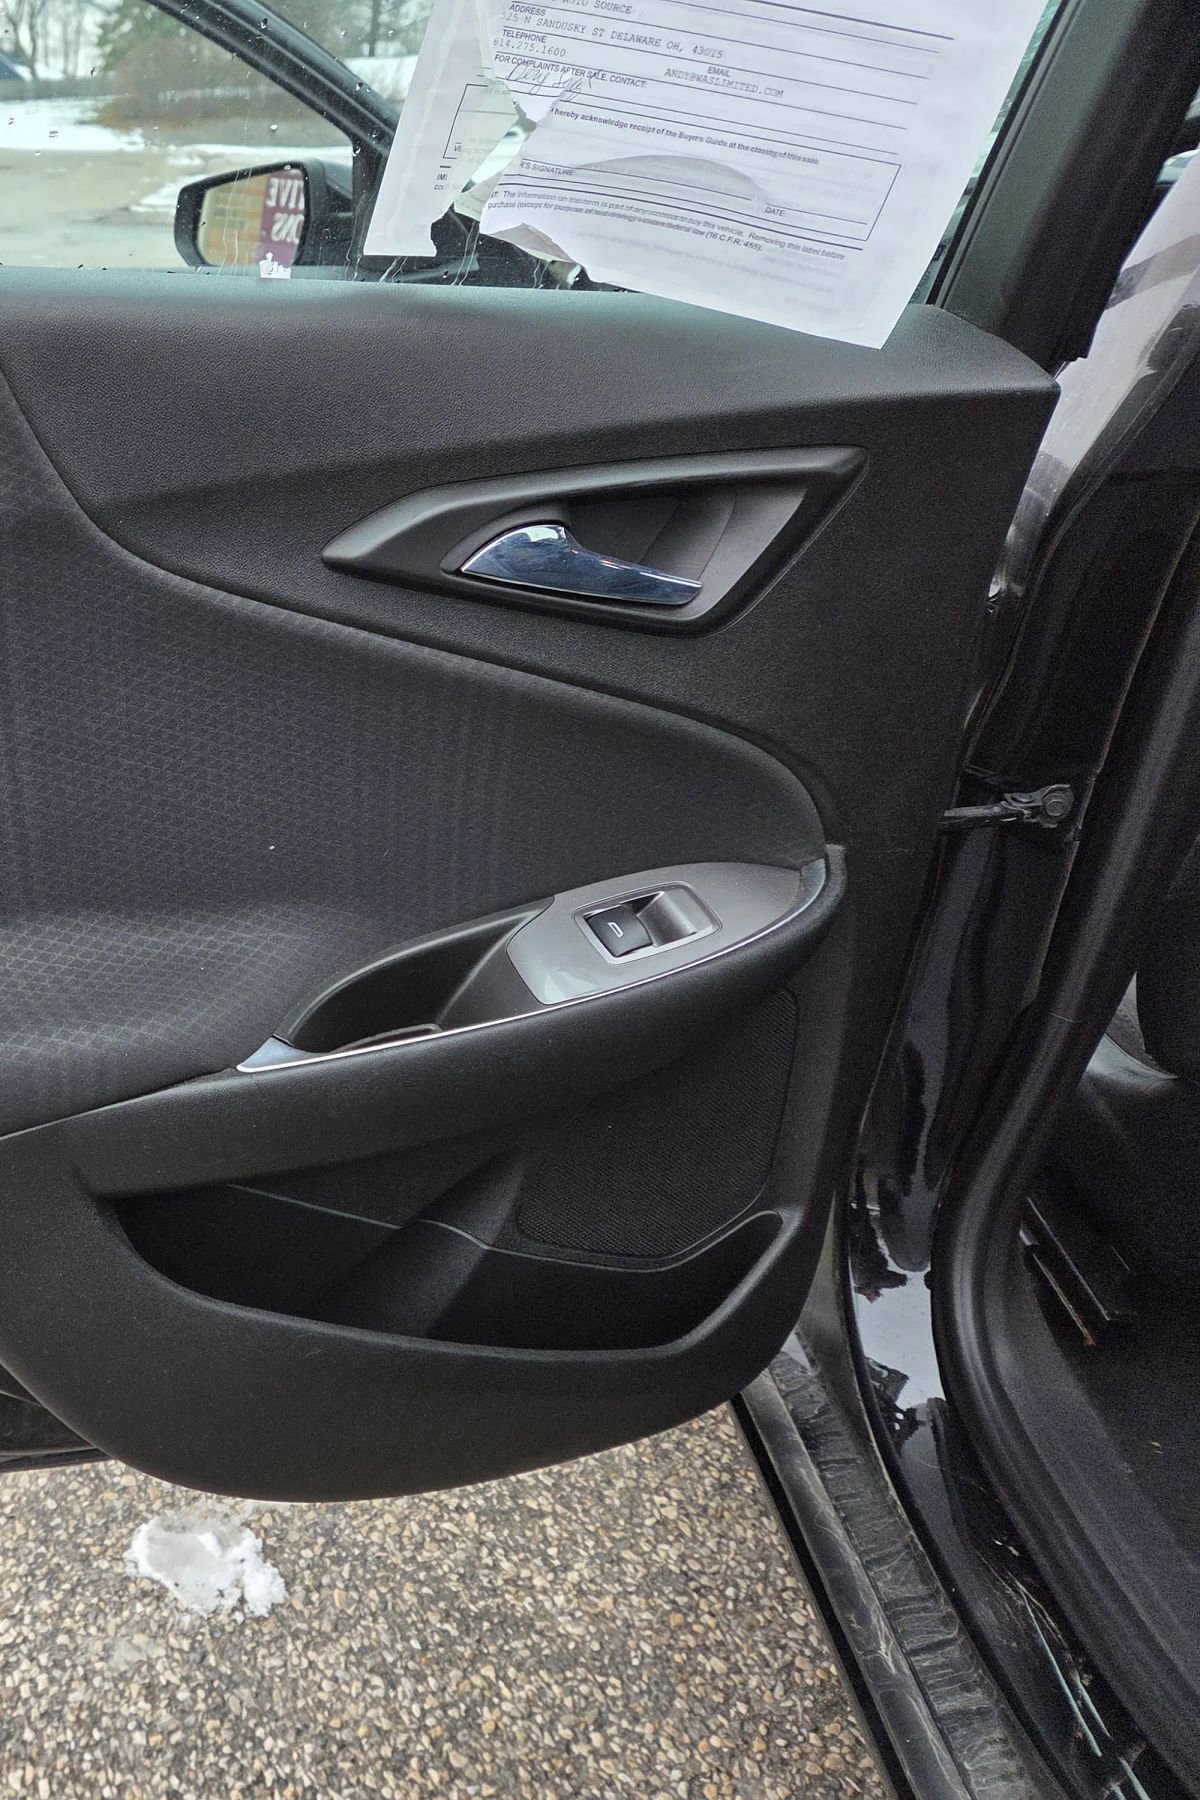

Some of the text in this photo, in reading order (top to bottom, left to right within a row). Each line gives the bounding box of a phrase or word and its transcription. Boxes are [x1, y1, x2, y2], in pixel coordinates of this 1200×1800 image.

[509, 4, 546, 16] ADDRESS
[594, 1, 632, 15] SOURCE
[502, 29, 547, 43] TELEPHONE
[524, 15, 532, 24] N
[536, 17, 587, 34] SANDUSKY
[592, 27, 605, 37] ST
[611, 30, 662, 47] DELAWARE
[666, 40, 684, 53] OH,
[692, 45, 724, 59] 43015
[493, 38, 566, 57] 614.275.1600
[494, 54, 510, 64] FOR
[511, 56, 560, 73] COMPLAINTS
[560, 66, 585, 78] AFTER
[707, 66, 731, 77] EMAIL
[554, 108, 579, 120] hereby
[580, 114, 629, 129] acknowledge
[629, 123, 656, 135] receipt
[657, 127, 666, 136] of
[666, 129, 677, 138] the
[705, 136, 728, 148] Guide
[738, 143, 750, 152] the
[532, 163, 575, 176] SIGNATURE
[488, 201, 516, 210] purchase
[765, 206, 786, 217] DATE
[749, 232, 786, 249] Removing
